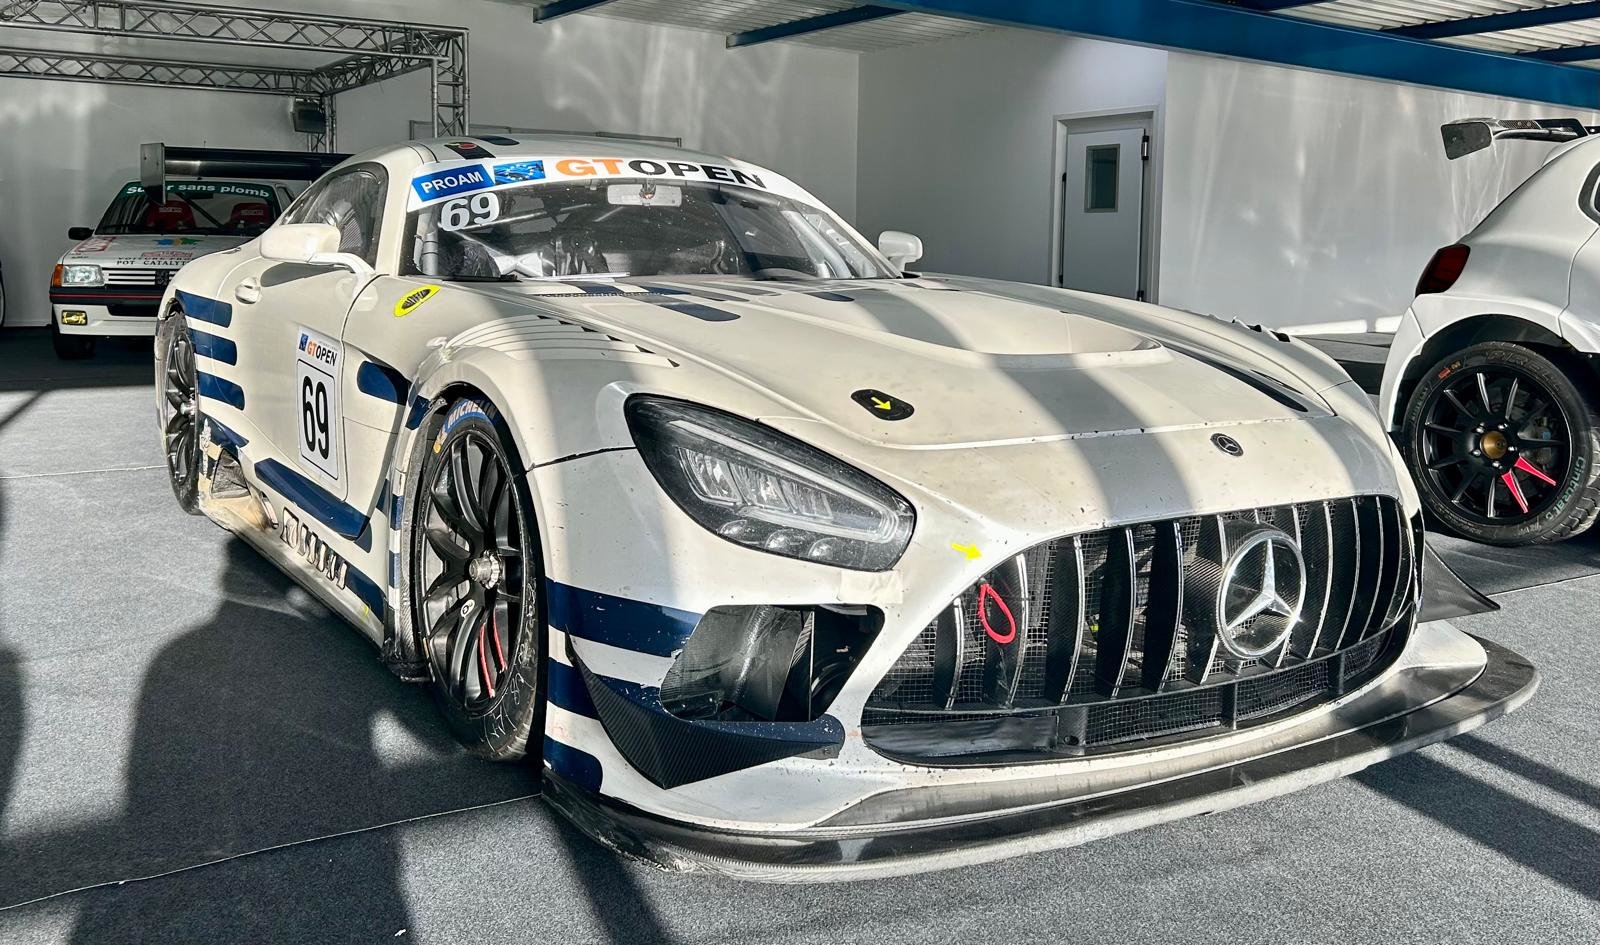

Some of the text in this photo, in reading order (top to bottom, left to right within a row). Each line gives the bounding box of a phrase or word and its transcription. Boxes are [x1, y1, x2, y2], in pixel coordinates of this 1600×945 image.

[126, 184, 270, 198] Sur sans plomb
[420, 170, 485, 194] PROAM
[440, 192, 500, 232] 69
[301, 375, 330, 460] 69
